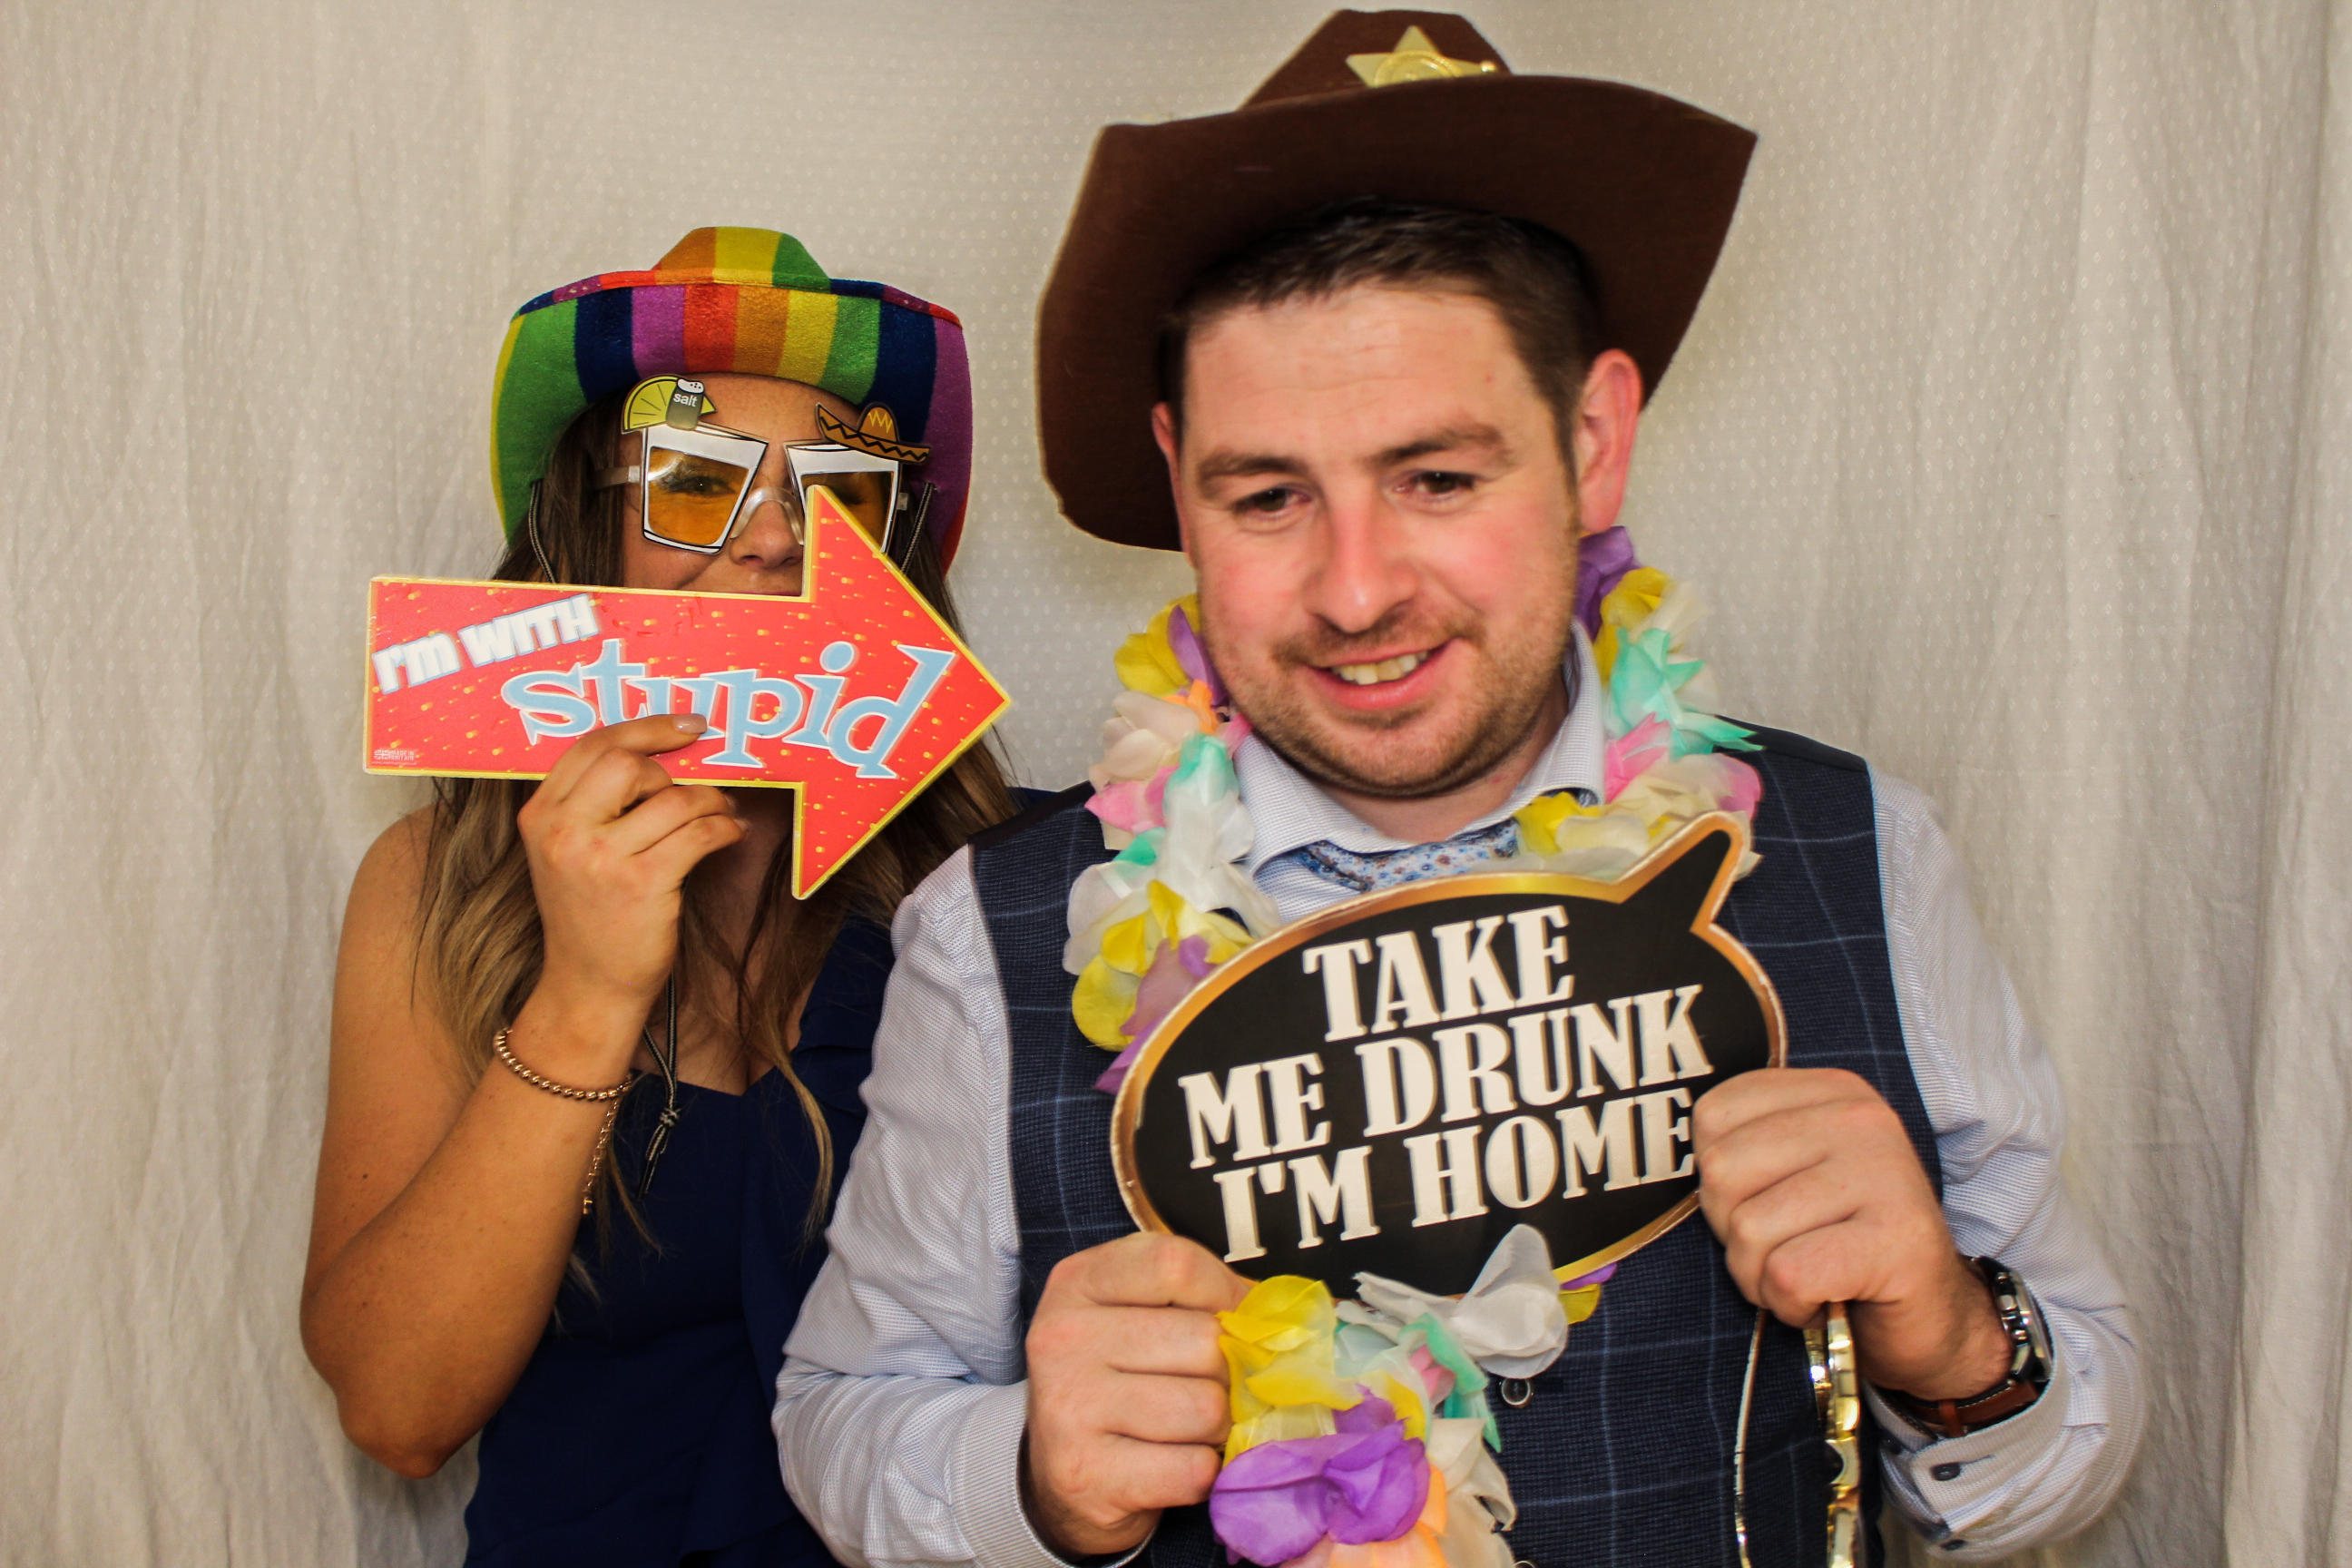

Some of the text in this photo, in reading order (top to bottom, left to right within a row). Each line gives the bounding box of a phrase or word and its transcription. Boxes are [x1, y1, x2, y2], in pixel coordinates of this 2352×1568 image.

[672, 393, 698, 407] salt
[456, 593, 600, 668] WITH
[500, 638, 956, 779] stupid
[1303, 905, 1574, 1044] TAKE
[1178, 984, 1714, 1170] ME DRUNK
[1212, 1087, 1695, 1263] I'M HOME
